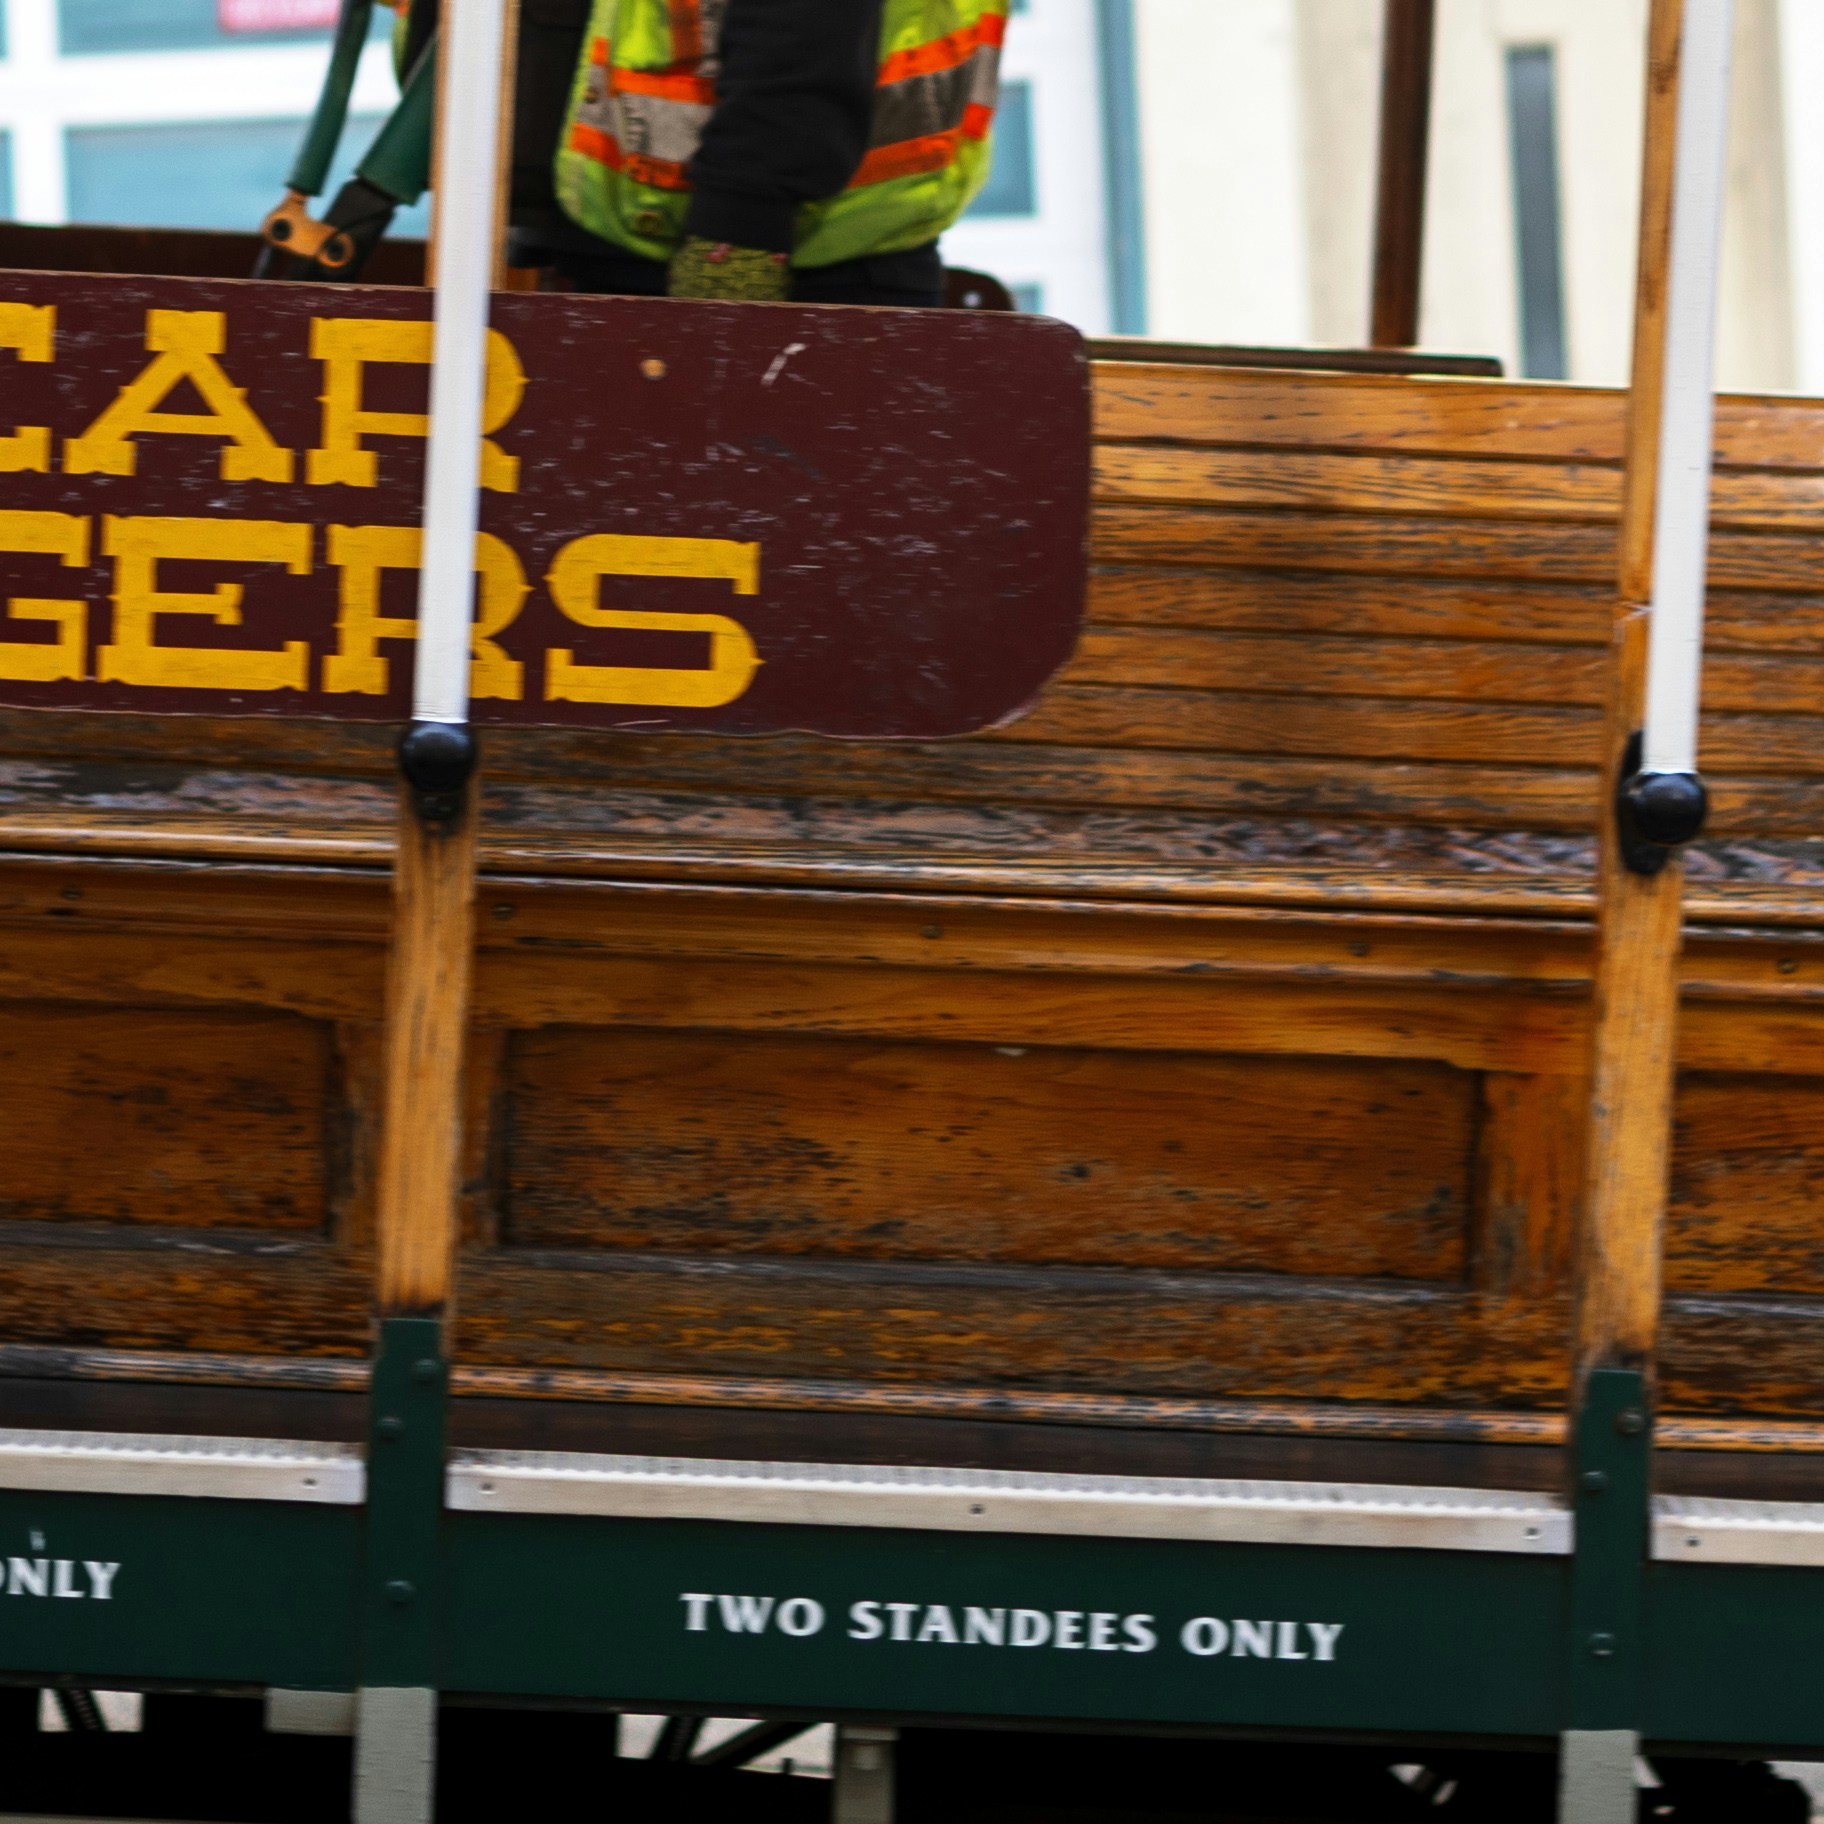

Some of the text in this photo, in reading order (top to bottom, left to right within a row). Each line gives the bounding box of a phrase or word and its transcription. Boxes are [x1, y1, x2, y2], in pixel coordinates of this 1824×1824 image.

[680, 1591, 1345, 1662] TWO STANDEES ONLY
